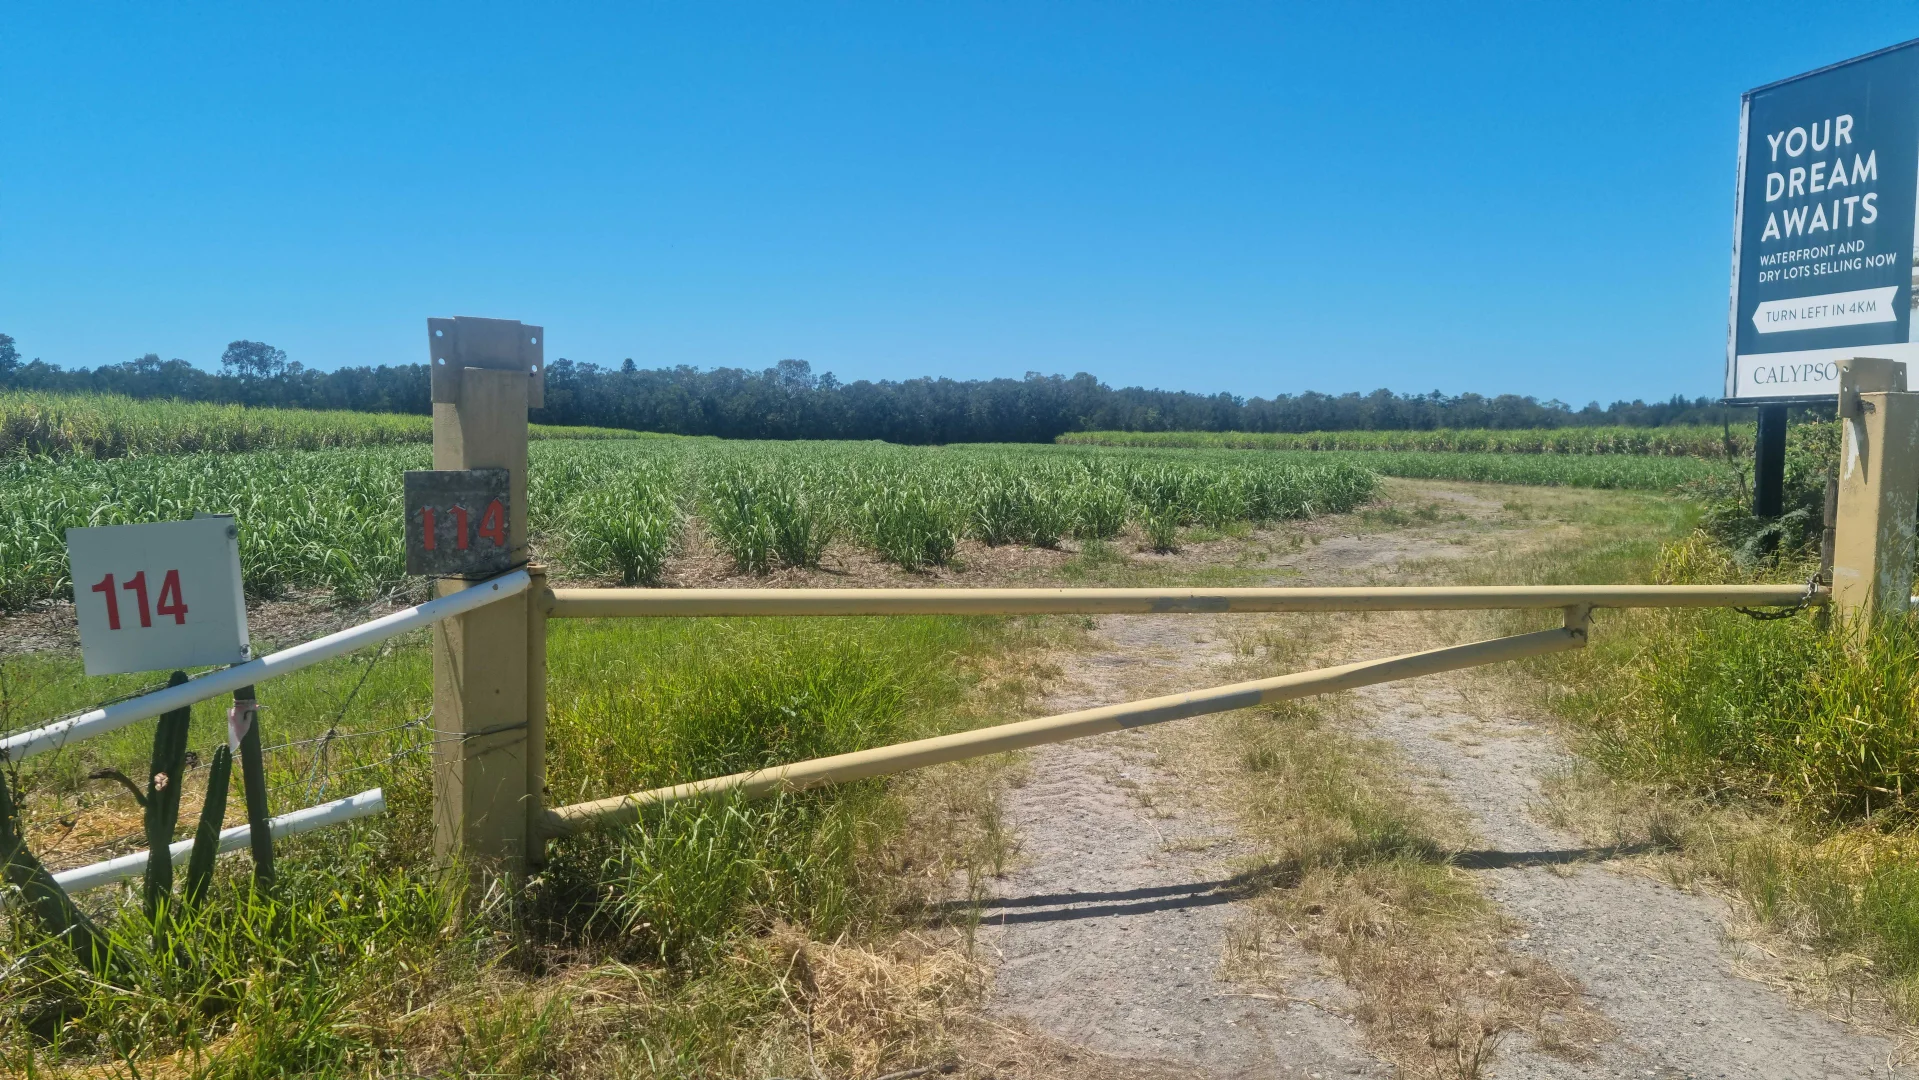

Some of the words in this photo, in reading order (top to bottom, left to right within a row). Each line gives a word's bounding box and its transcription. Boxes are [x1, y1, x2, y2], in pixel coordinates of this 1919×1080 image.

[1767, 114, 1854, 162] YOUR
[1766, 150, 1878, 202] DREAM
[1761, 193, 1878, 242] AWAITS
[1759, 270, 1781, 283] DRY
[1784, 265, 1810, 280] LOTS
[1813, 258, 1861, 275] SELLING
[1865, 252, 1897, 268] NOW
[1760, 244, 1835, 266] WATERFRONT
[1838, 240, 1865, 252] AND
[1766, 309, 1797, 322] TURN
[1801, 305, 1828, 319] LEFT
[1832, 303, 1845, 315] IN
[1849, 300, 1876, 313] 4KM
[1753, 361, 1839, 385] CALYPSO
[414, 497, 505, 550] 114
[92, 569, 189, 630] 114
